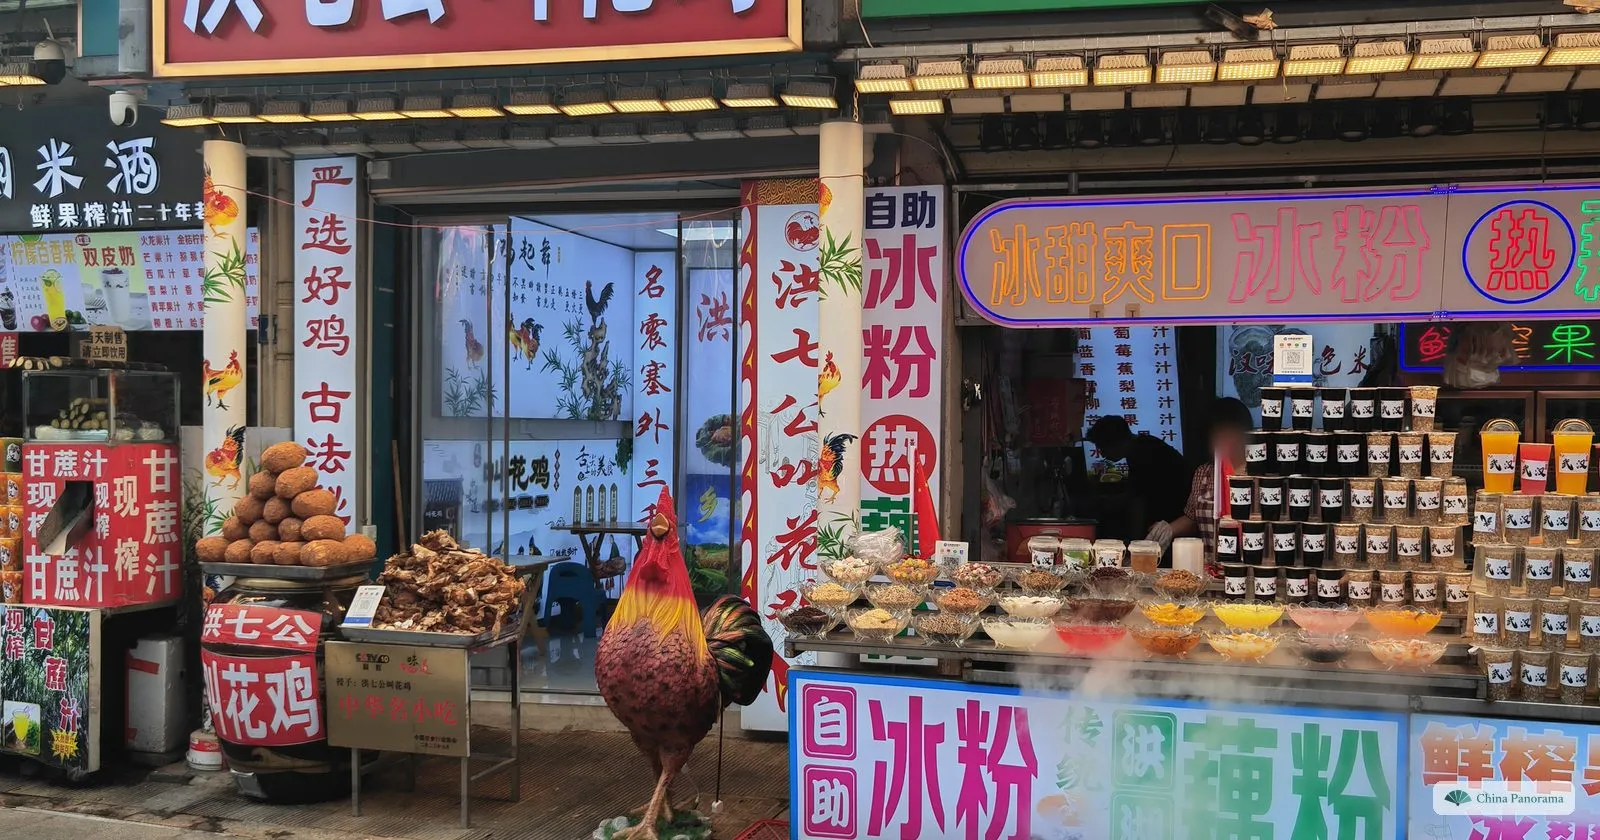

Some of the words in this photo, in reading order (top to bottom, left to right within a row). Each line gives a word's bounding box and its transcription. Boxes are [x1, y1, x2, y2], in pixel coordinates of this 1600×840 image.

[865, 191, 937, 230] 自助
[83, 246, 136, 267] 双皮奶
[302, 165, 353, 356] 严选好鸡
[989, 220, 1212, 307] 冰甜爽口
[1228, 205, 1431, 304] 冰粉
[1487, 209, 1556, 291] 热
[697, 291, 733, 343] 洪
[862, 234, 937, 399] 冰粉
[25, 450, 108, 477] 甘蔗汁
[1489, 458, 1515, 470] 武汉
[1522, 464, 1546, 477] 武汉
[1561, 458, 1587, 470] 武汉
[96, 482, 110, 540] 现榨
[114, 476, 139, 582] 现榨
[143, 449, 179, 596] 甘蔗汁
[26, 546, 109, 602] 甘蔗汁
[6, 609, 25, 661] 现榨
[203, 607, 315, 645] 洪七公
[33, 616, 81, 732] 甘蔗汁
[203, 660, 320, 741] 叫花鸡
[811, 696, 850, 828] 自助
[867, 695, 1039, 840] 冰粉
[1182, 715, 1392, 840] 藕粉
[1419, 721, 1600, 797] 鲜榨
